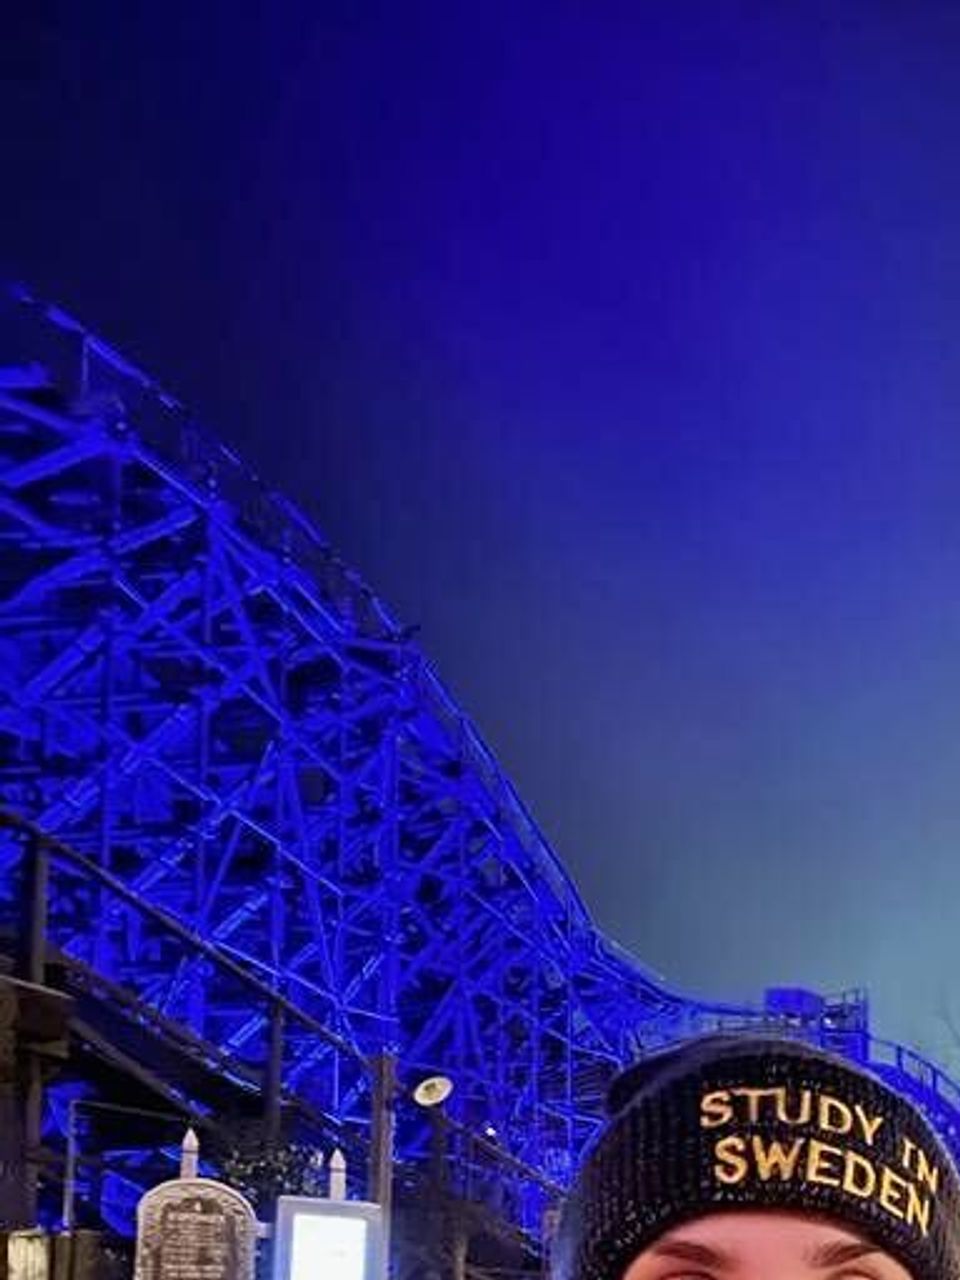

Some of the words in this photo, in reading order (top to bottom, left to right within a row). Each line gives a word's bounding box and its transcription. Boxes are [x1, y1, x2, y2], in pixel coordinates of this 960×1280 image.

[700, 1086, 883, 1146] STUDY
[902, 1138, 938, 1194] IN
[714, 1135, 930, 1236] SWEDEN
